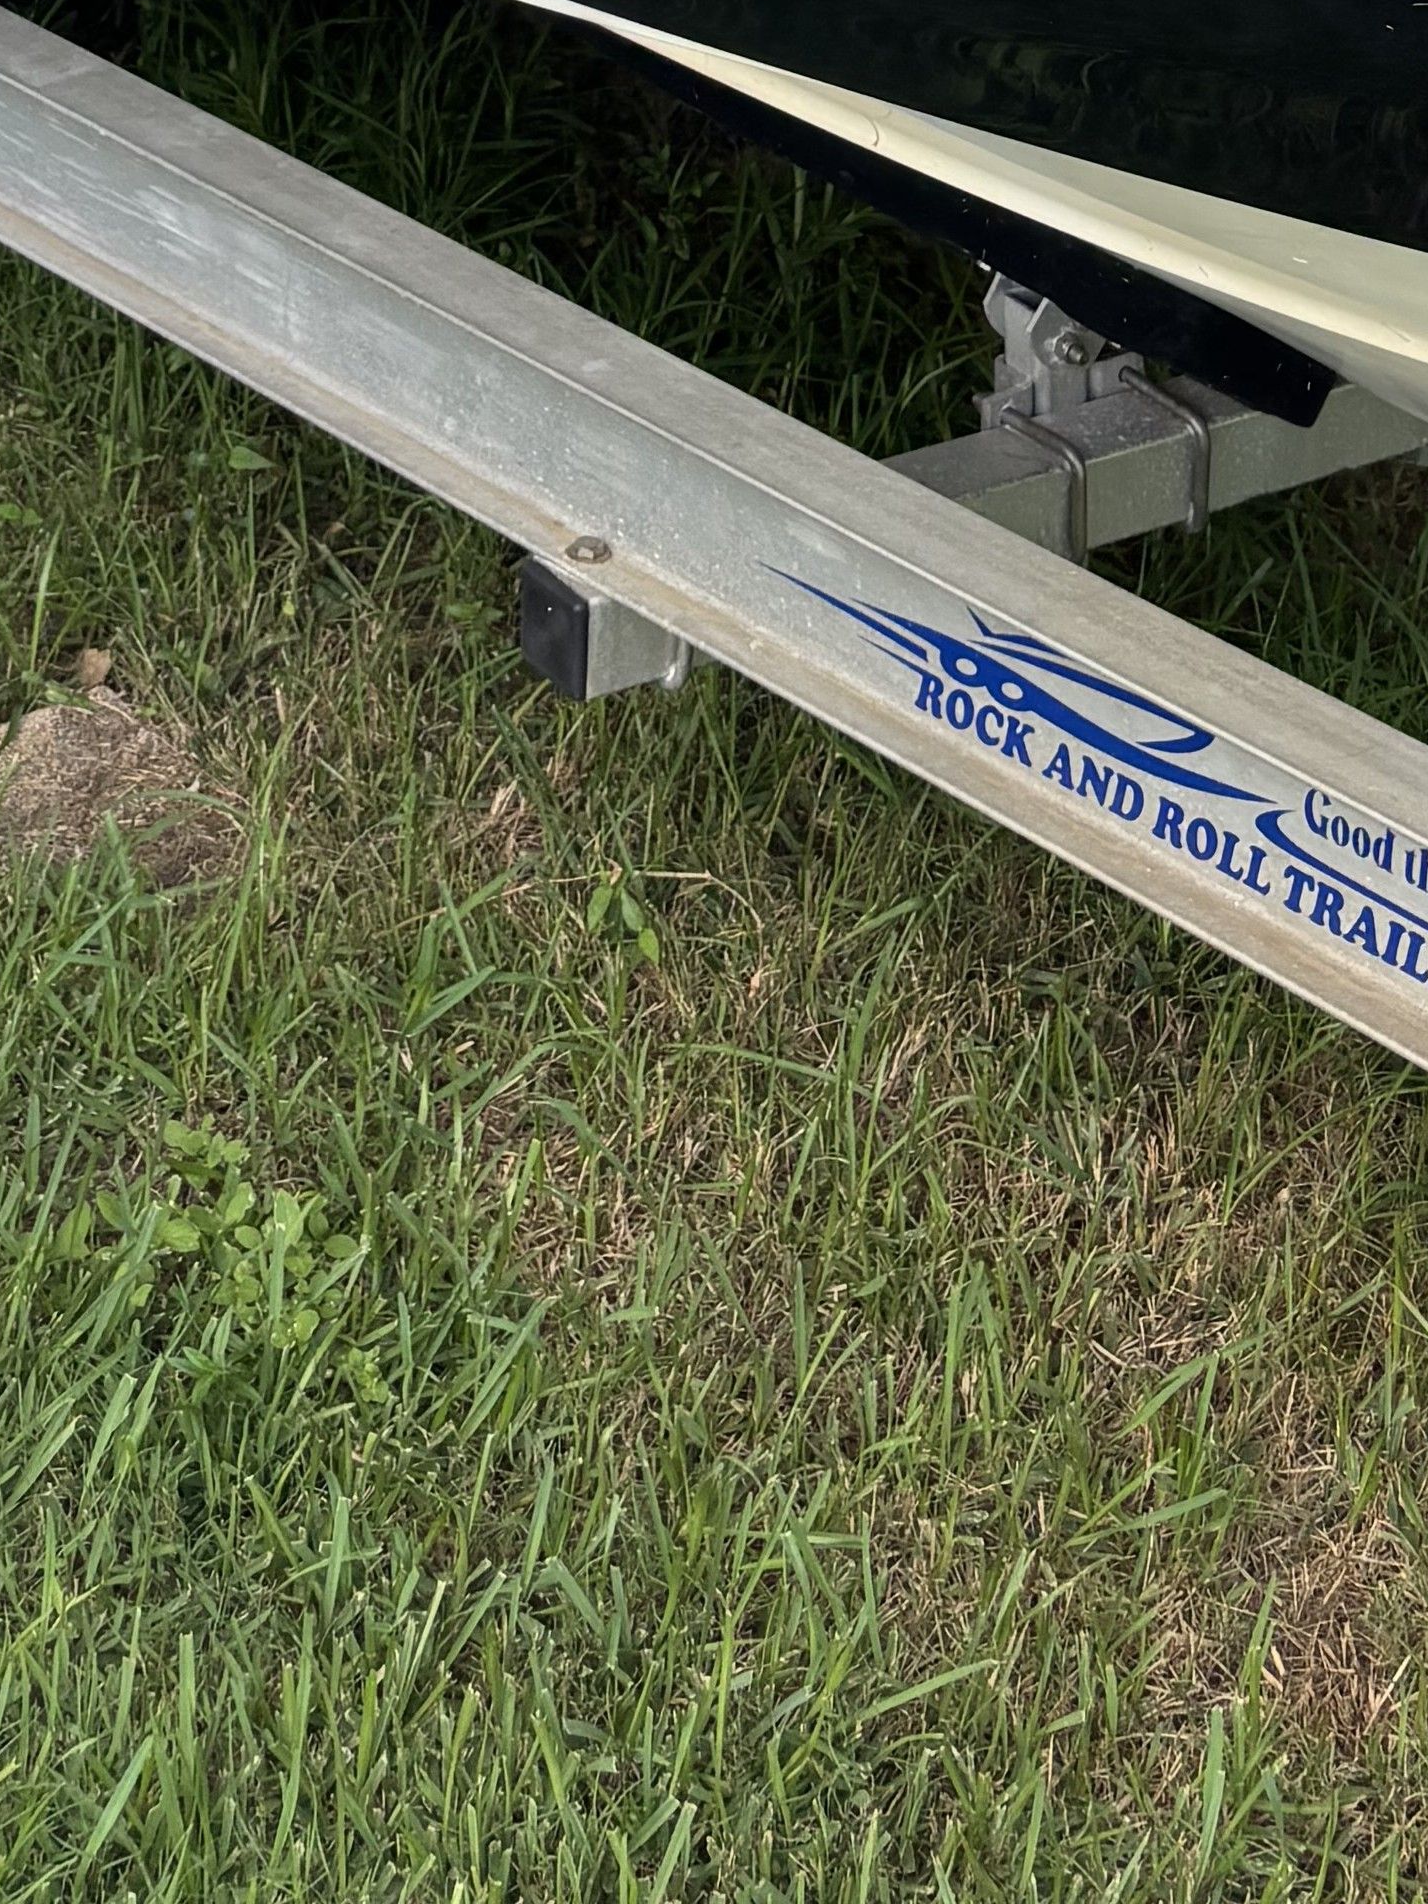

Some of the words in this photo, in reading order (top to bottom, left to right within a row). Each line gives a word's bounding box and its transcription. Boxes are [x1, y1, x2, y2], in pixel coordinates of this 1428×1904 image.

[914, 672, 1036, 768] ROCK
[1041, 742, 1145, 822] AND
[1152, 796, 1270, 895] ROLL
[1303, 789, 1394, 871] Good
